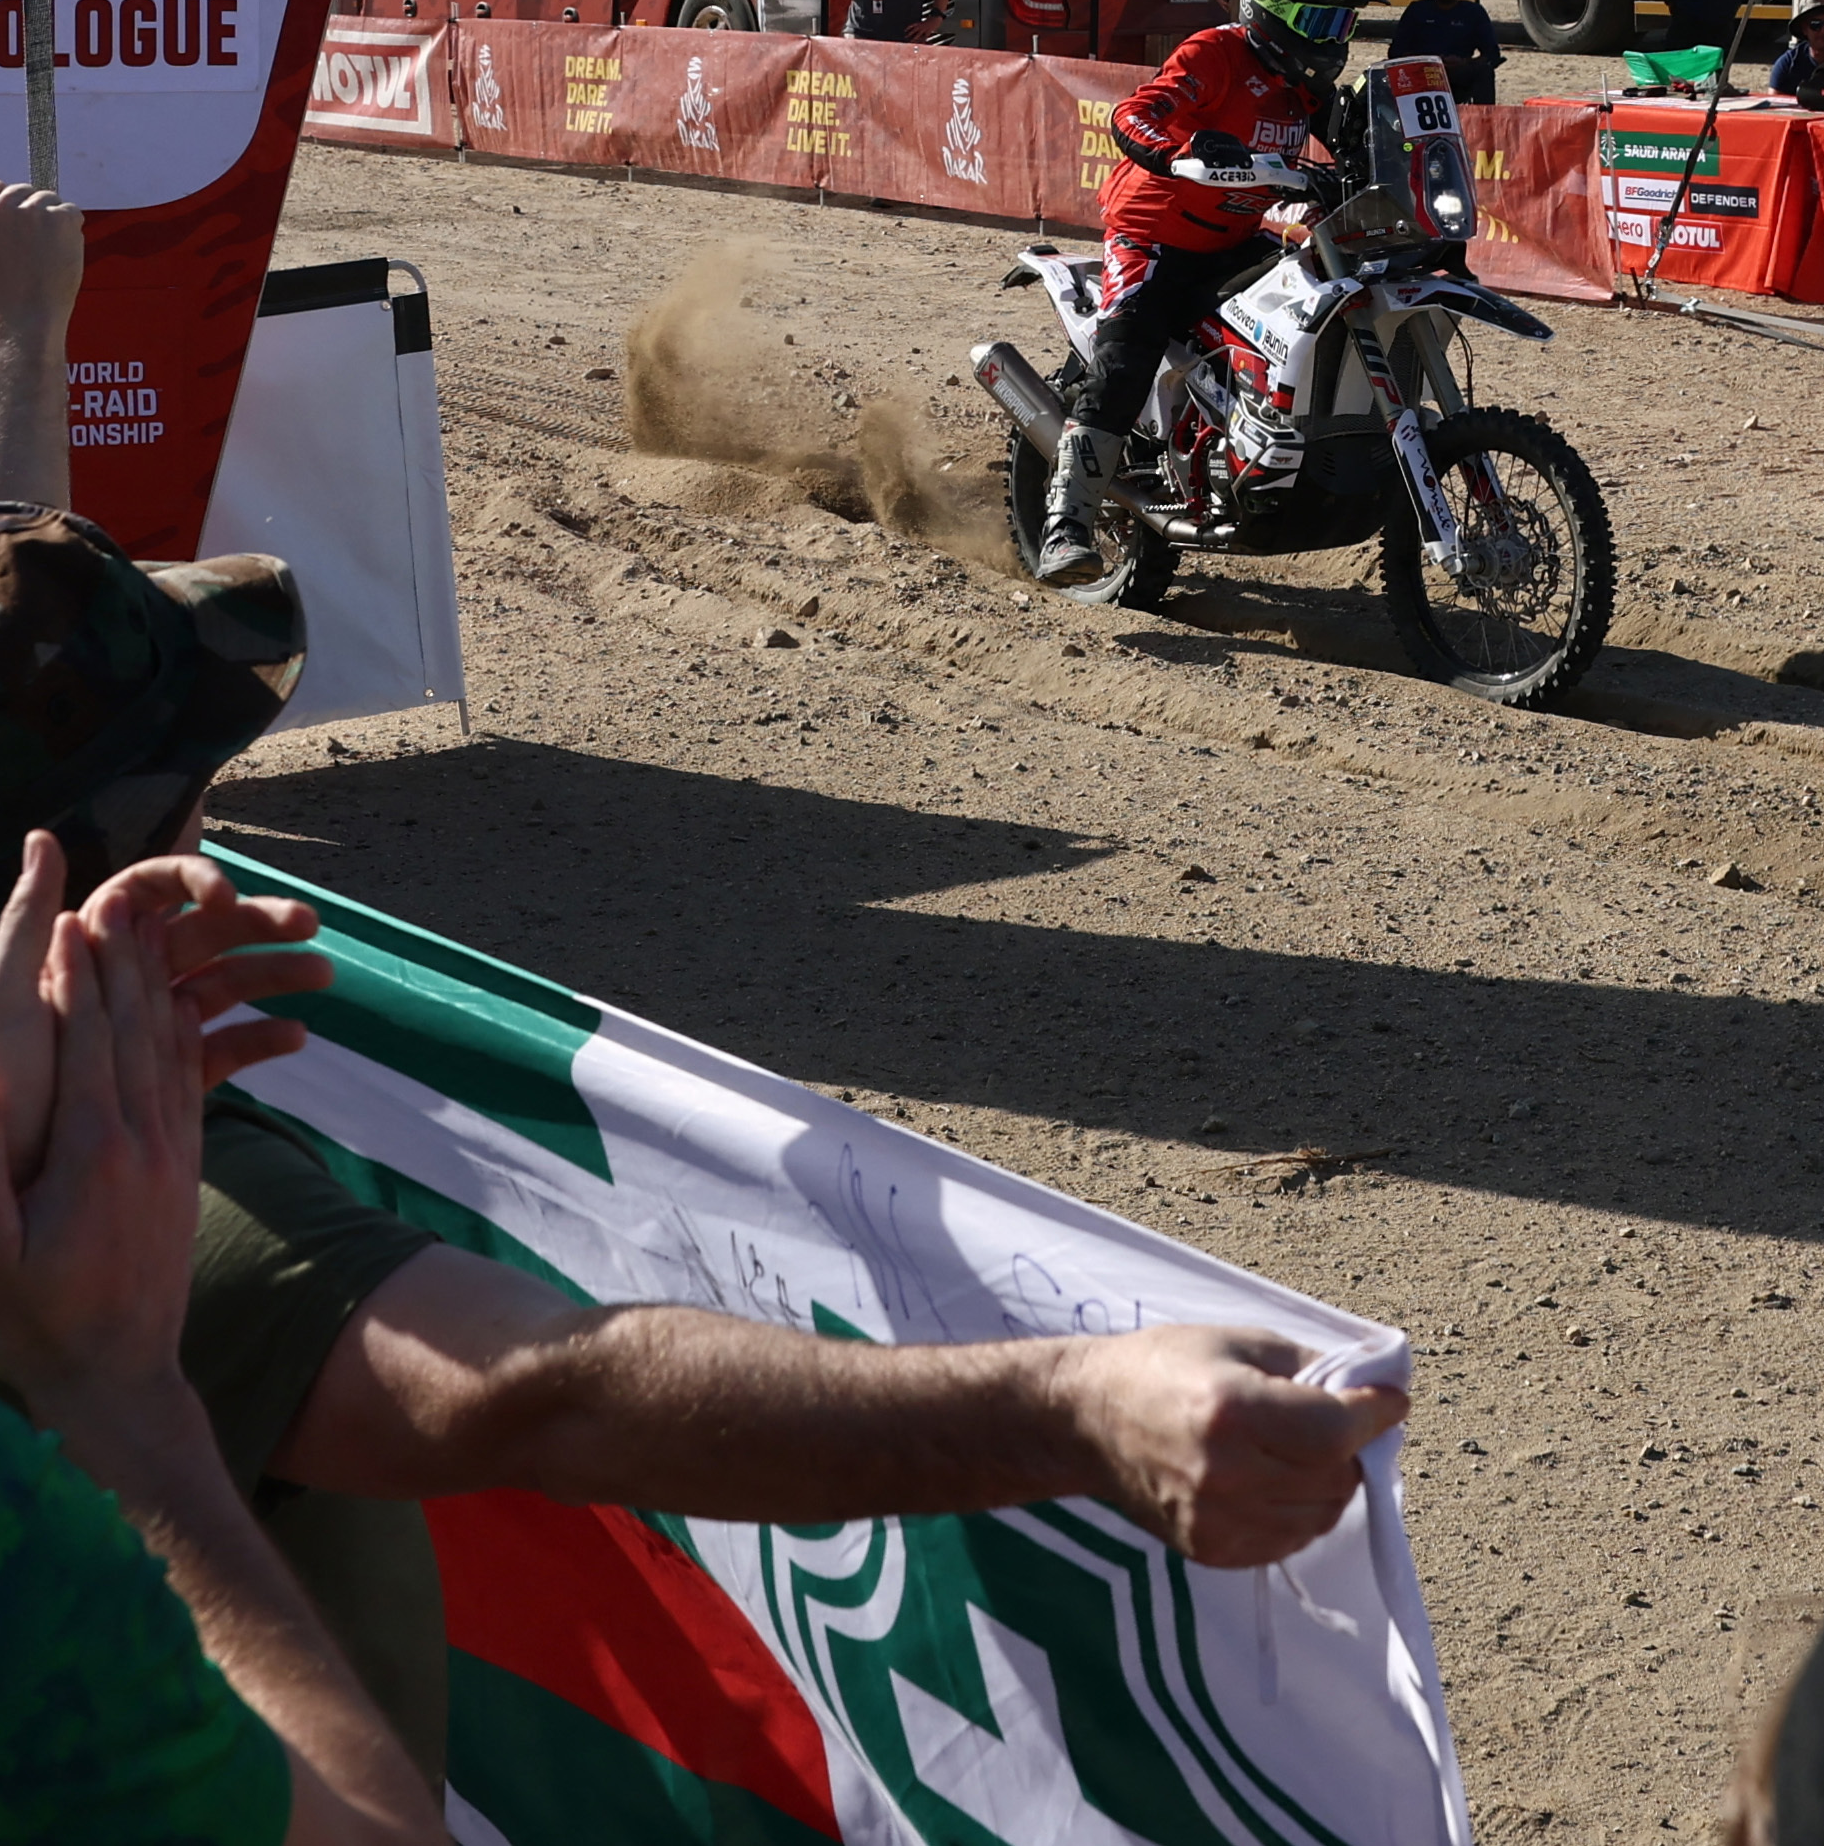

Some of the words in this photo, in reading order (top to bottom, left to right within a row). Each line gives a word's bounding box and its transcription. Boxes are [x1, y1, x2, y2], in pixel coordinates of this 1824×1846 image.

[564, 55, 623, 82] DREAM.
[566, 84, 608, 108] DARE.
[786, 69, 858, 100] DREAM.
[565, 109, 593, 134] LIVE
[594, 112, 613, 136] IT.
[786, 98, 841, 128] DARE.
[1414, 94, 1452, 131] 88
[786, 126, 827, 156] LIVE
[829, 131, 853, 158] IT.
[1248, 118, 1308, 148] jauni
[941, 144, 988, 185] DAKAR
[1624, 143, 1659, 159] SAUDI
[1661, 146, 1706, 163] ARAA
[1208, 169, 1257, 182] ACERBIS
[1690, 192, 1757, 209] DEFENDER
[1262, 327, 1289, 360] jaunin
